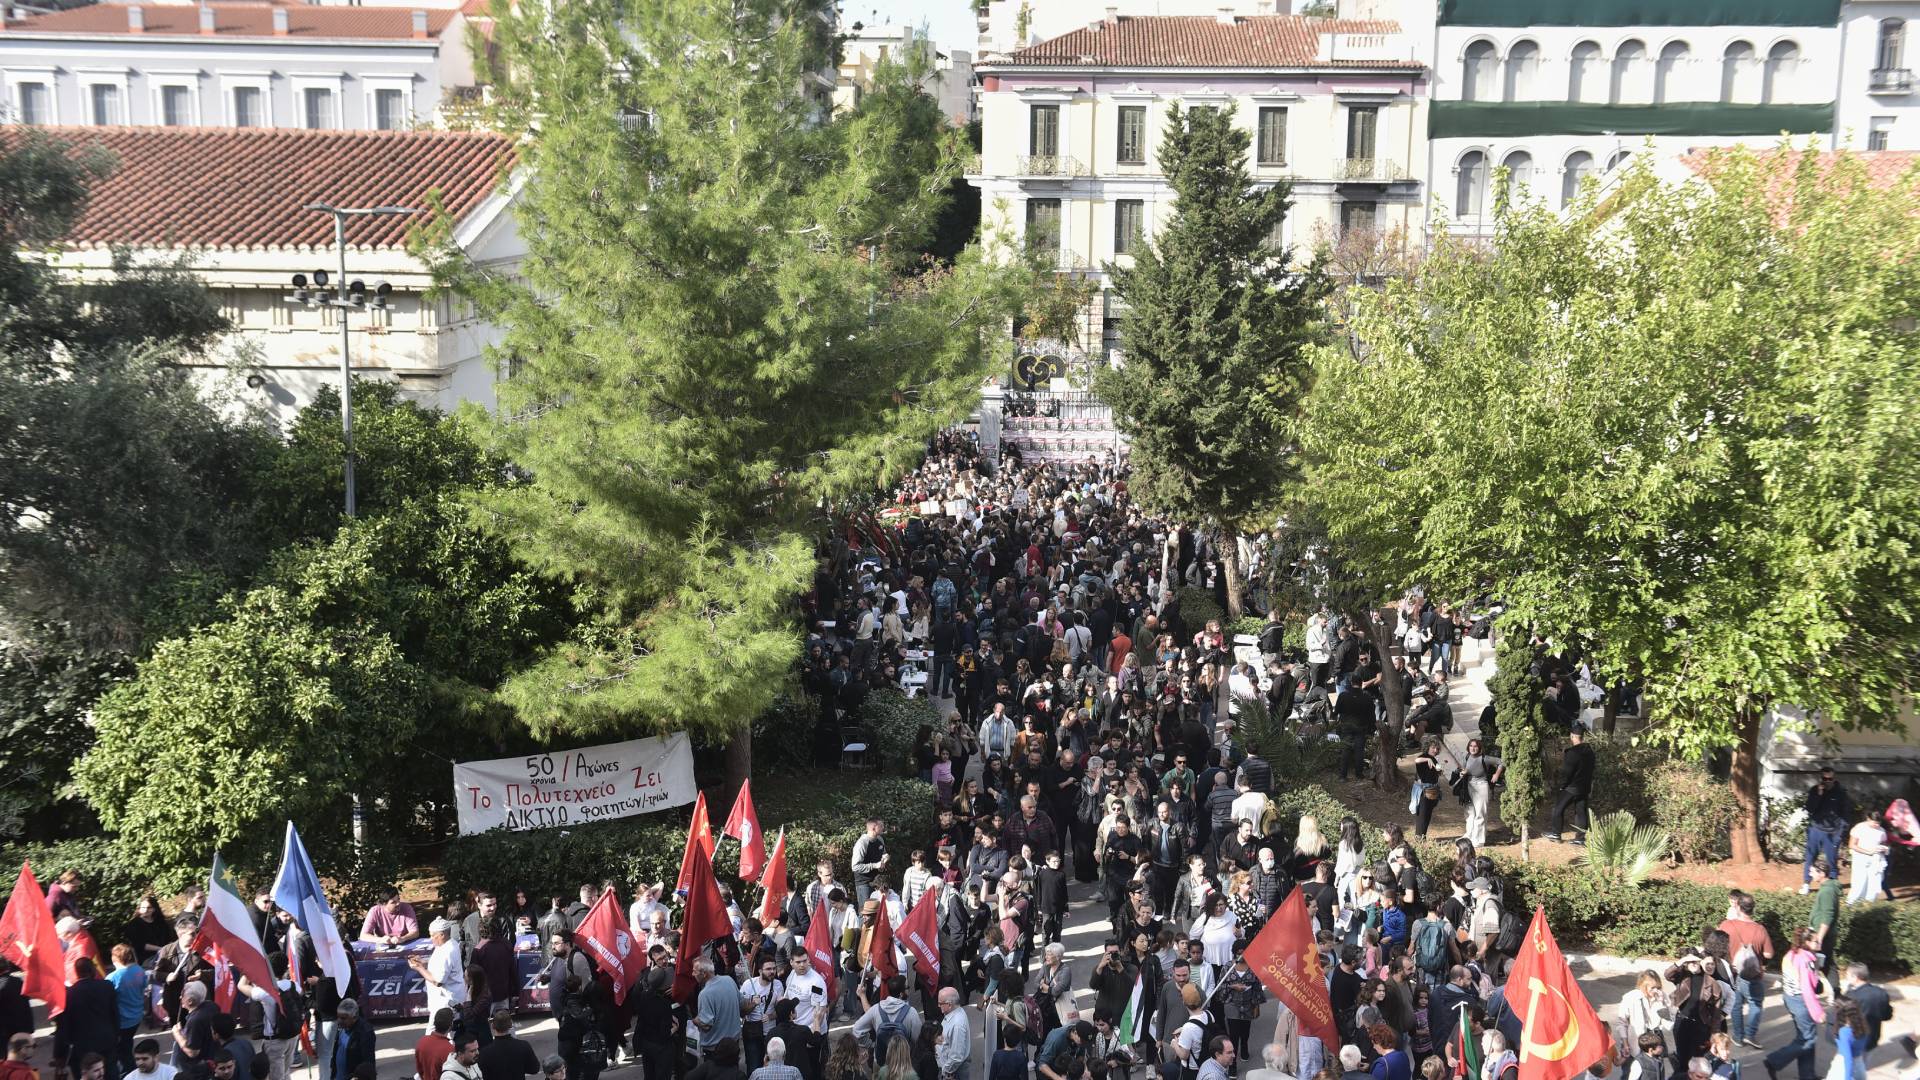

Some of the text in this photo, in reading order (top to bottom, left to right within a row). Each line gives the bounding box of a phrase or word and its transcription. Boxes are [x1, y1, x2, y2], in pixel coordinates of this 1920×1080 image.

[526, 756, 554, 777] 50
[576, 752, 619, 778] Αγώνες
[468, 766, 661, 809] Το Πολυτεχνείο Ζει
[530, 776, 556, 784] χρόνια
[506, 806, 568, 829] ΔΙΚΤΥΟ
[368, 979, 401, 996] Ζει
[1268, 965, 1329, 1025] ORGANISATION
